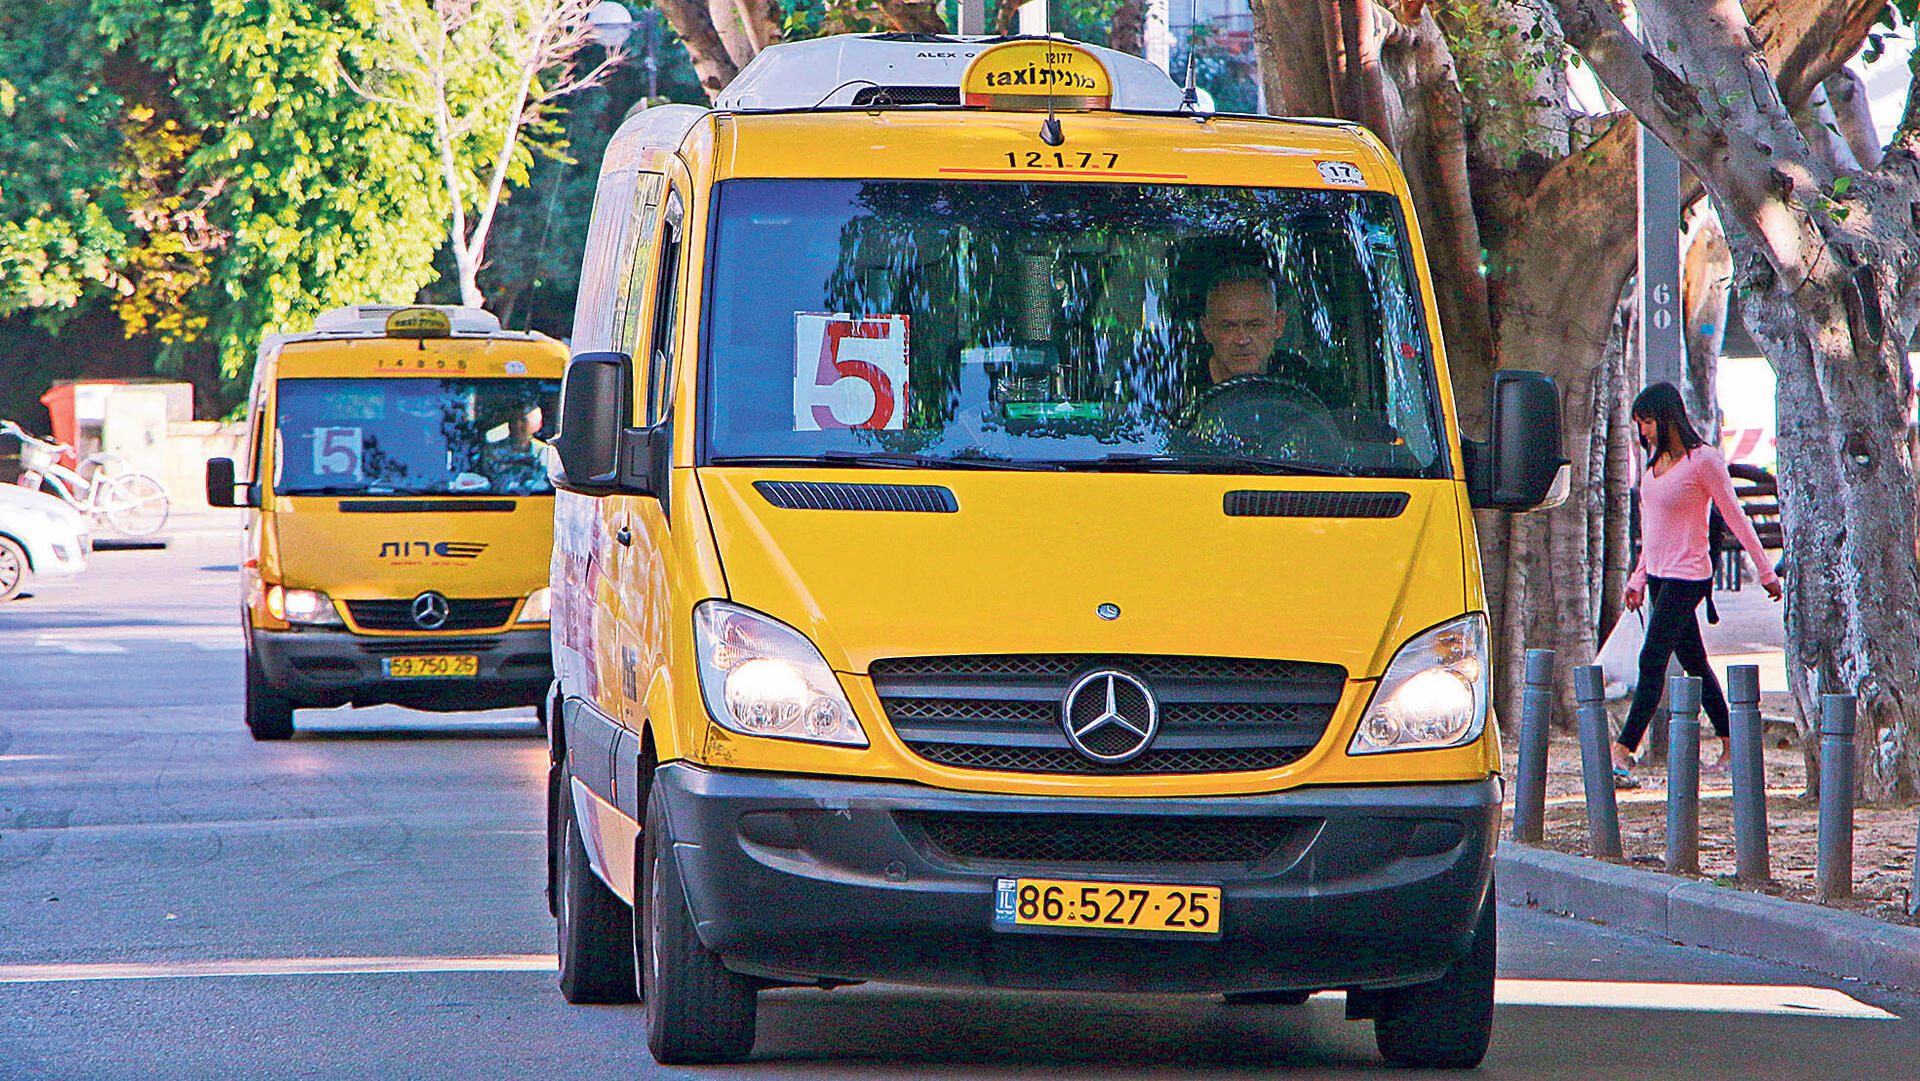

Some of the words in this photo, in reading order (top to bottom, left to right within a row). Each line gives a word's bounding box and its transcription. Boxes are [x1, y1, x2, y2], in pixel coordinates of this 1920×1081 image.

[1045, 52, 1073, 64] 12177
[986, 62, 1036, 87] taxi
[1038, 68, 1096, 89] מונית
[1329, 166, 1351, 177] 17
[811, 320, 895, 430] 5
[321, 429, 357, 477] 5
[999, 890, 1013, 910] IL
